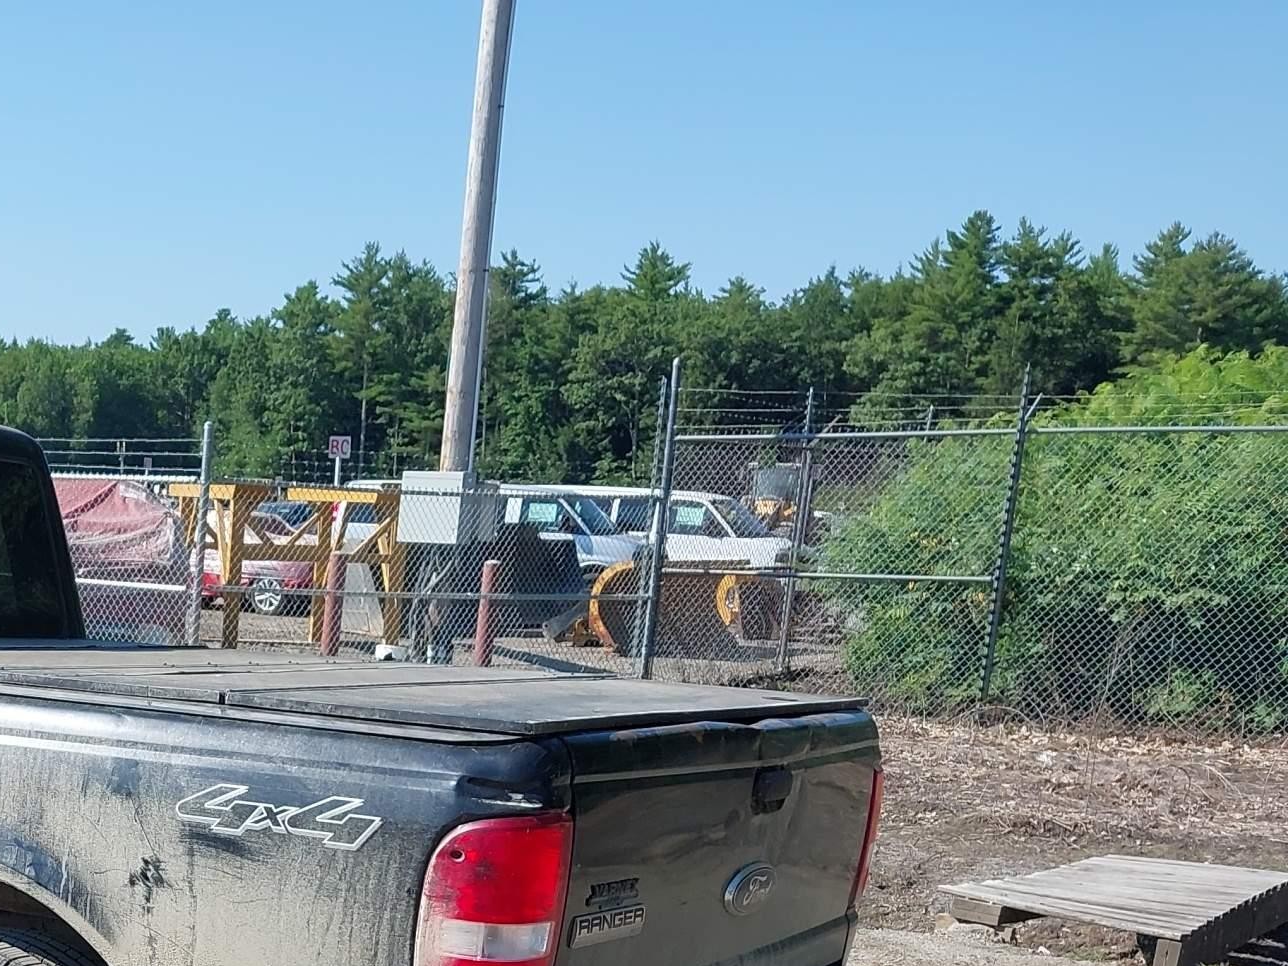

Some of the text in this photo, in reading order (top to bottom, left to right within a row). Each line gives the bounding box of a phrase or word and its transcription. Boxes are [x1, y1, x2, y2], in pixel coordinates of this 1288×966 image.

[331, 439, 350, 455] BC
[743, 876, 773, 906] Ford
[578, 908, 644, 936] RANGER
